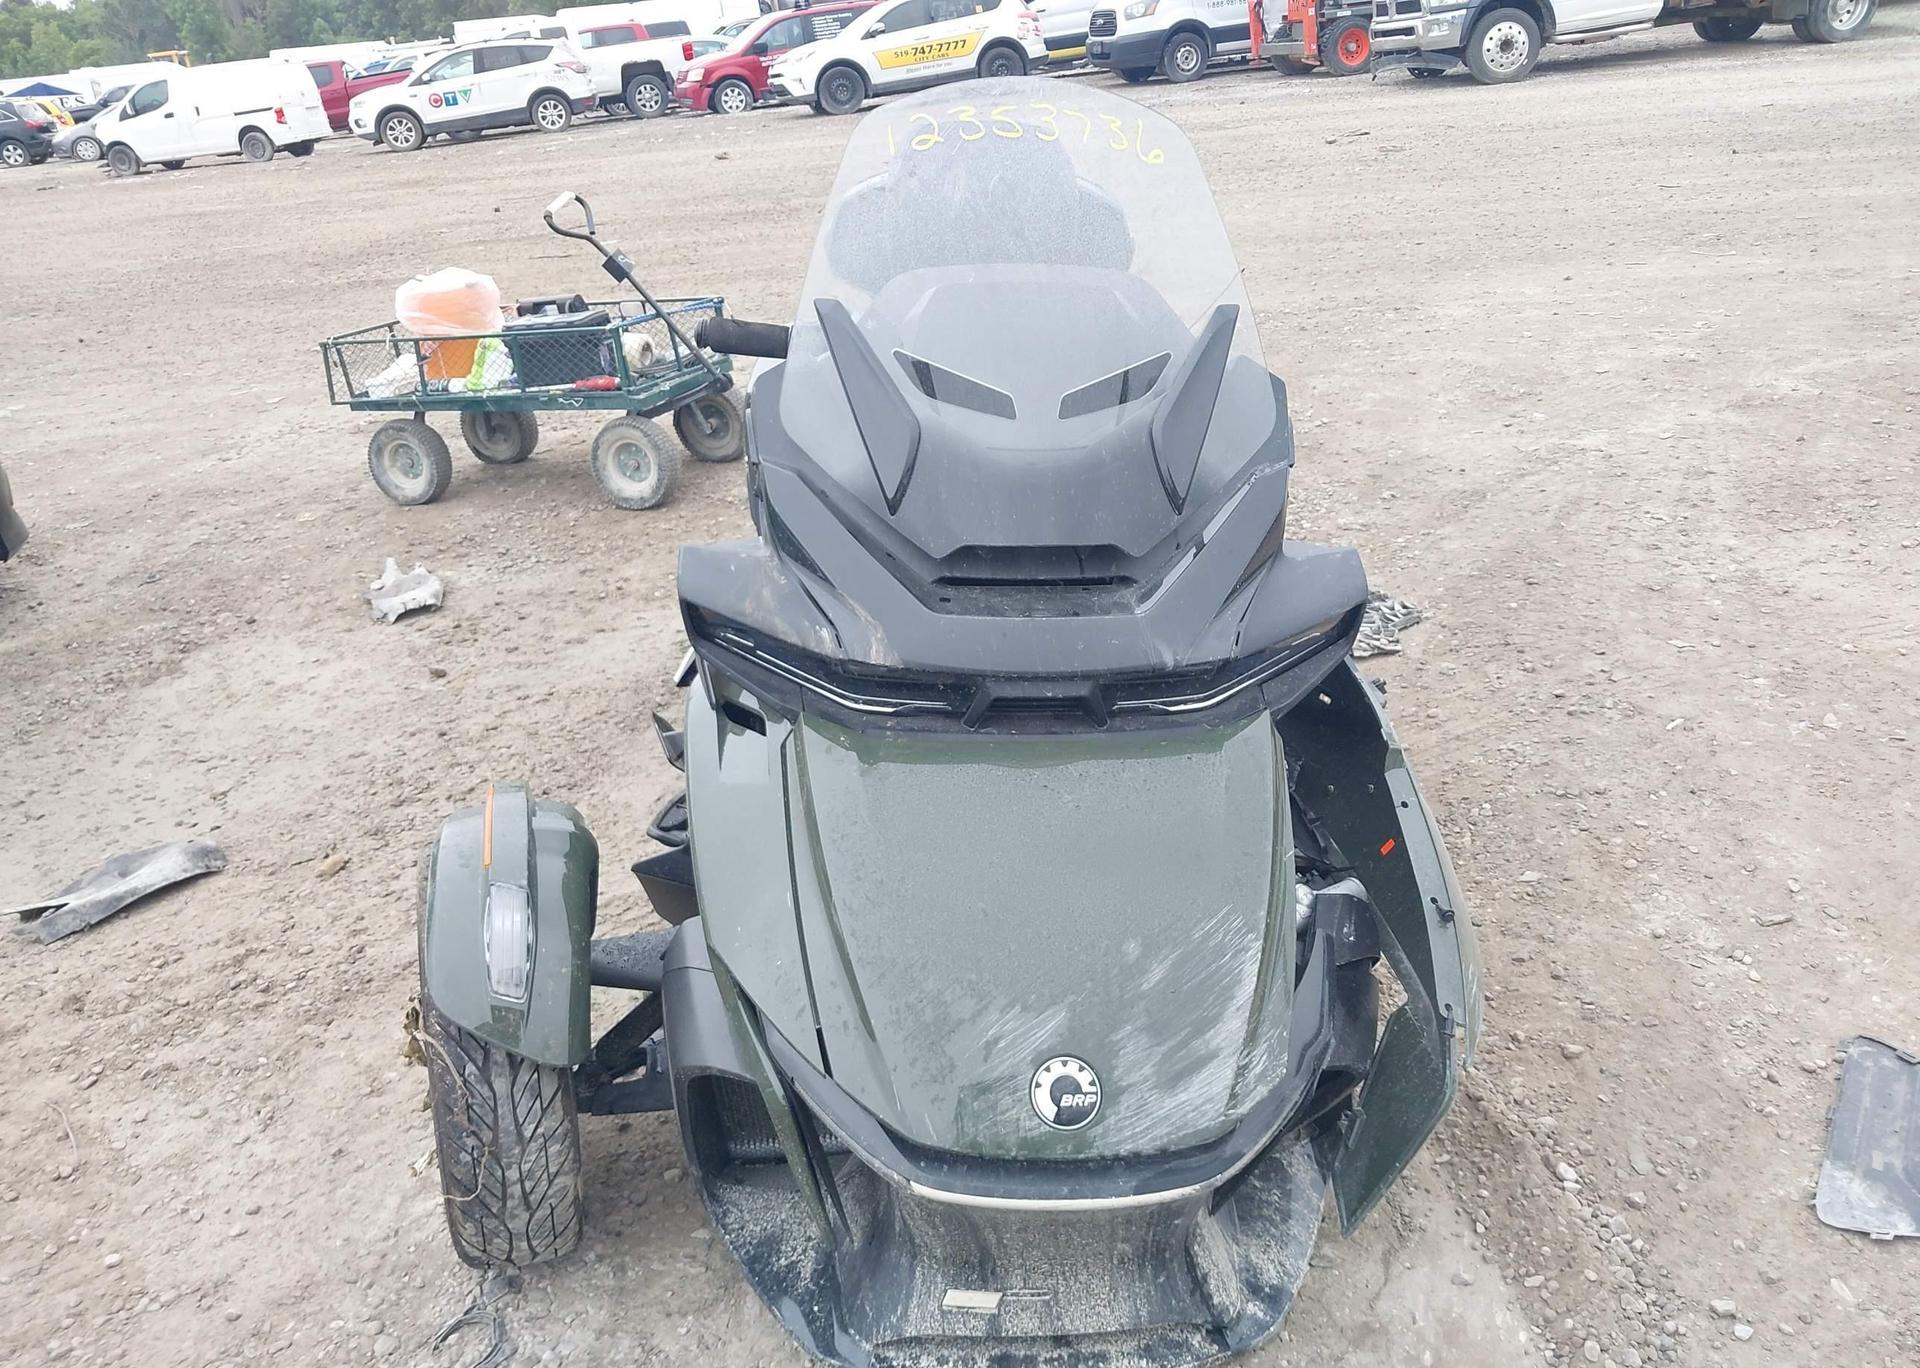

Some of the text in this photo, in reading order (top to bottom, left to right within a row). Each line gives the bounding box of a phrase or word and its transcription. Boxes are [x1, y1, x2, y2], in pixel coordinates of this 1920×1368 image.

[894, 39, 967, 58] 519-747-7777
[429, 88, 472, 108] CTV
[887, 103, 1164, 165] 12353736
[1060, 1094, 1097, 1107] BRP
